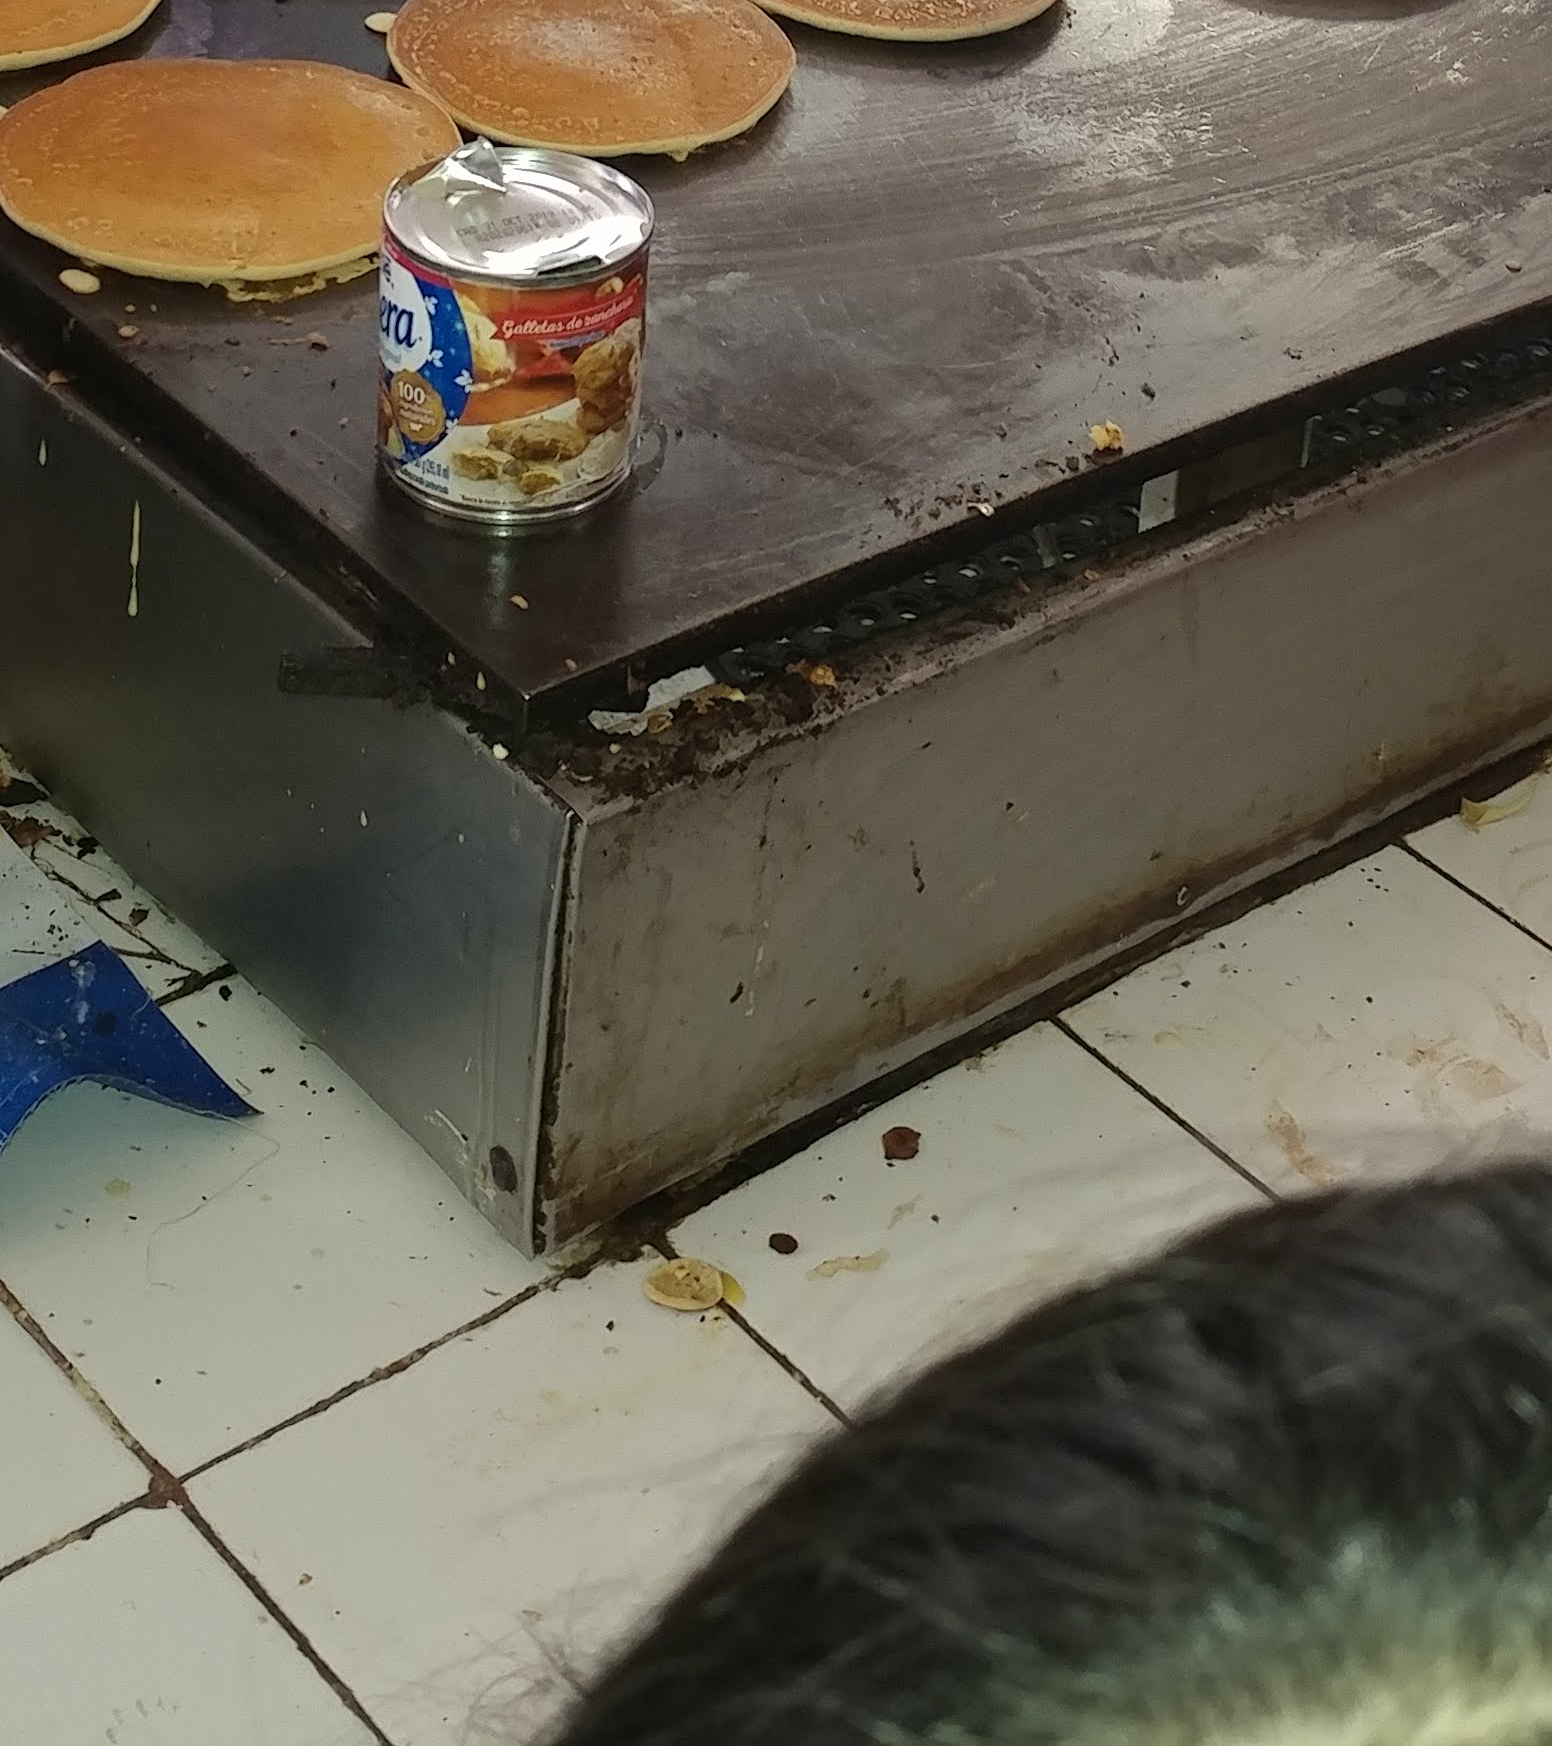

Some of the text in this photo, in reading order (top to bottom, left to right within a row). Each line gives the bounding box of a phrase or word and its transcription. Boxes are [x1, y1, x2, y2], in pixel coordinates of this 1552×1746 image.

[502, 318, 564, 339] Galletas
[566, 314, 582, 330] de
[398, 380, 426, 404] 100
